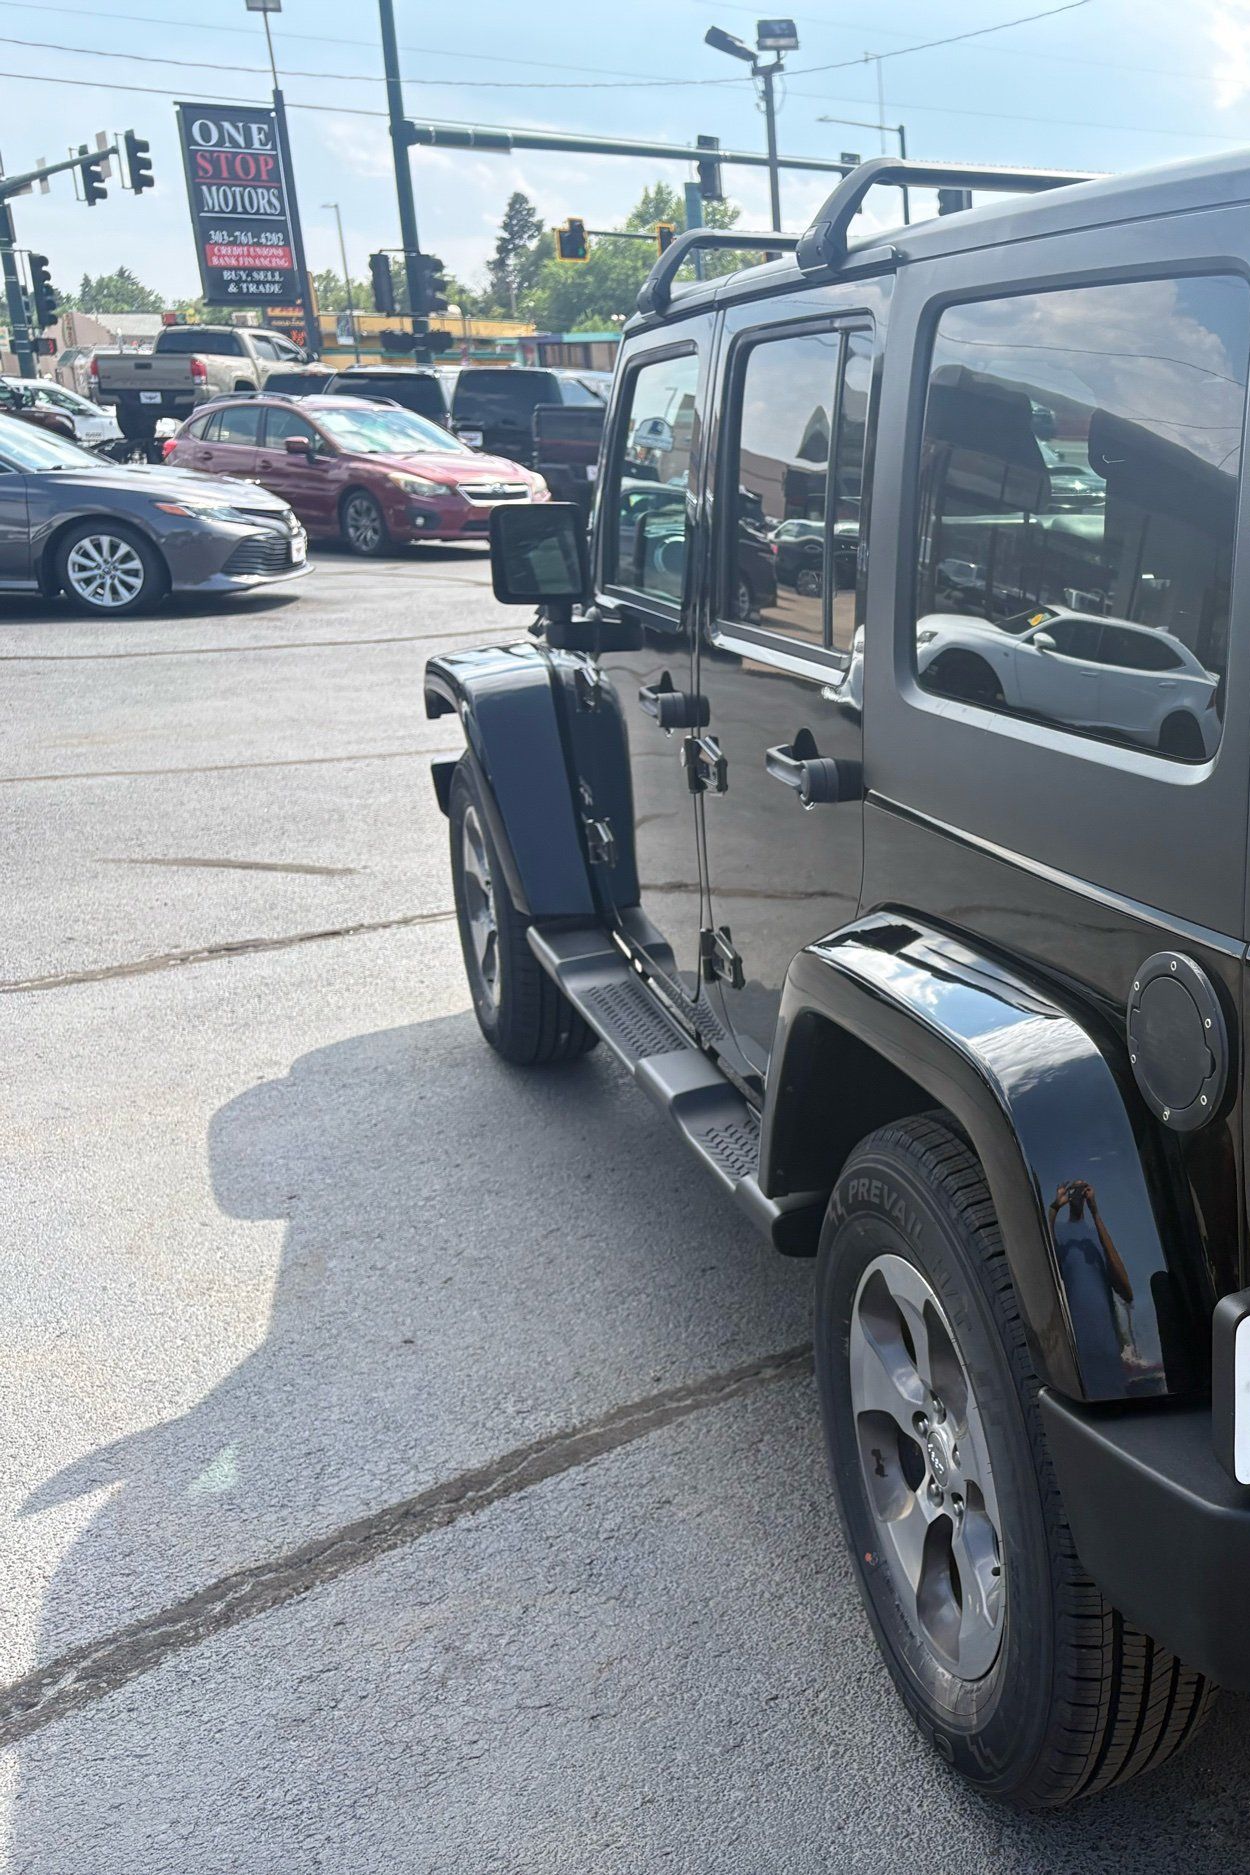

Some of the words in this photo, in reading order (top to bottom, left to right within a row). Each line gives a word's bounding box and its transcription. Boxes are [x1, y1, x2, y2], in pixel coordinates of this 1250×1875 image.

[191, 119, 272, 150] ONE
[195, 152, 274, 181] STOP
[200, 184, 281, 215] MOTORS
[211, 256, 238, 266] BANK
[227, 282, 239, 293] &
[239, 282, 283, 294] TRADE
[252, 270, 284, 282] SELL
[849, 1177, 924, 1239] PREVAIL
